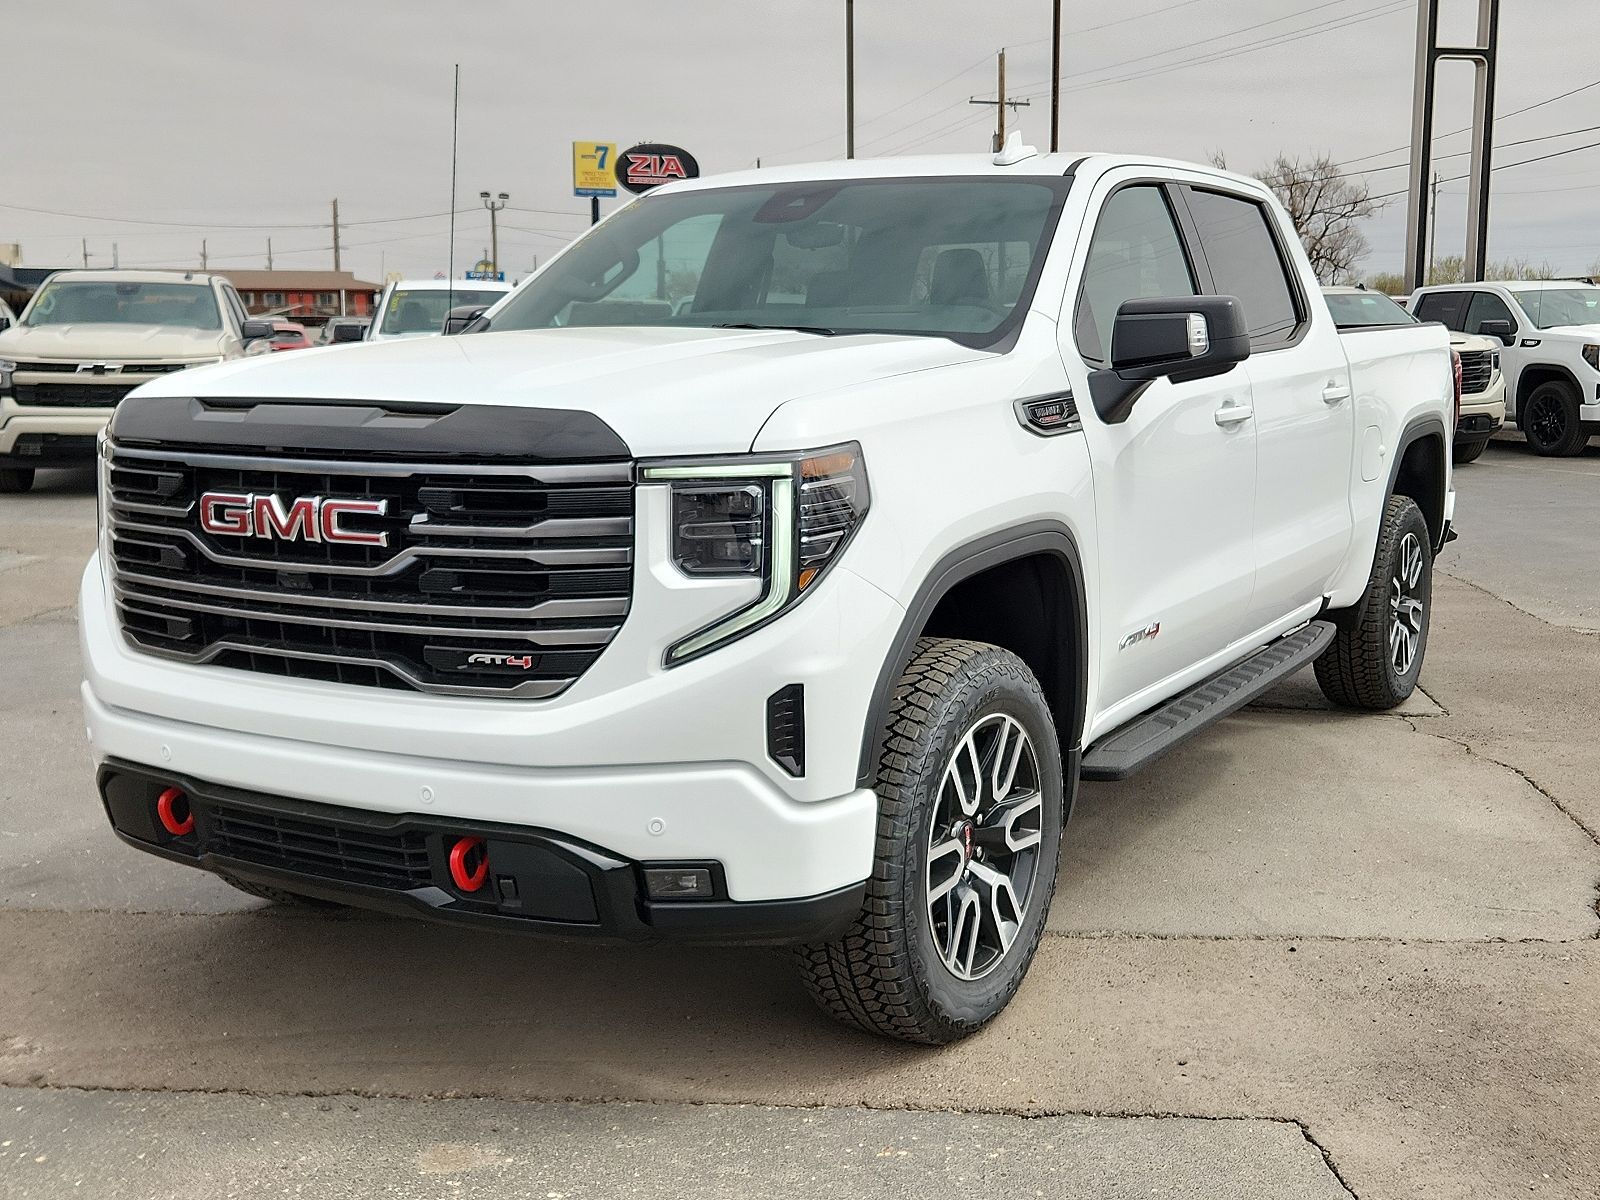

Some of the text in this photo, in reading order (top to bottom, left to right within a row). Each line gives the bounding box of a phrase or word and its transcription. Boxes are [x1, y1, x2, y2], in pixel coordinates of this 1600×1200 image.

[595, 145, 609, 171] 7
[626, 153, 687, 179] ZIA
[200, 492, 389, 548] GMC
[468, 653, 533, 670] AT4
